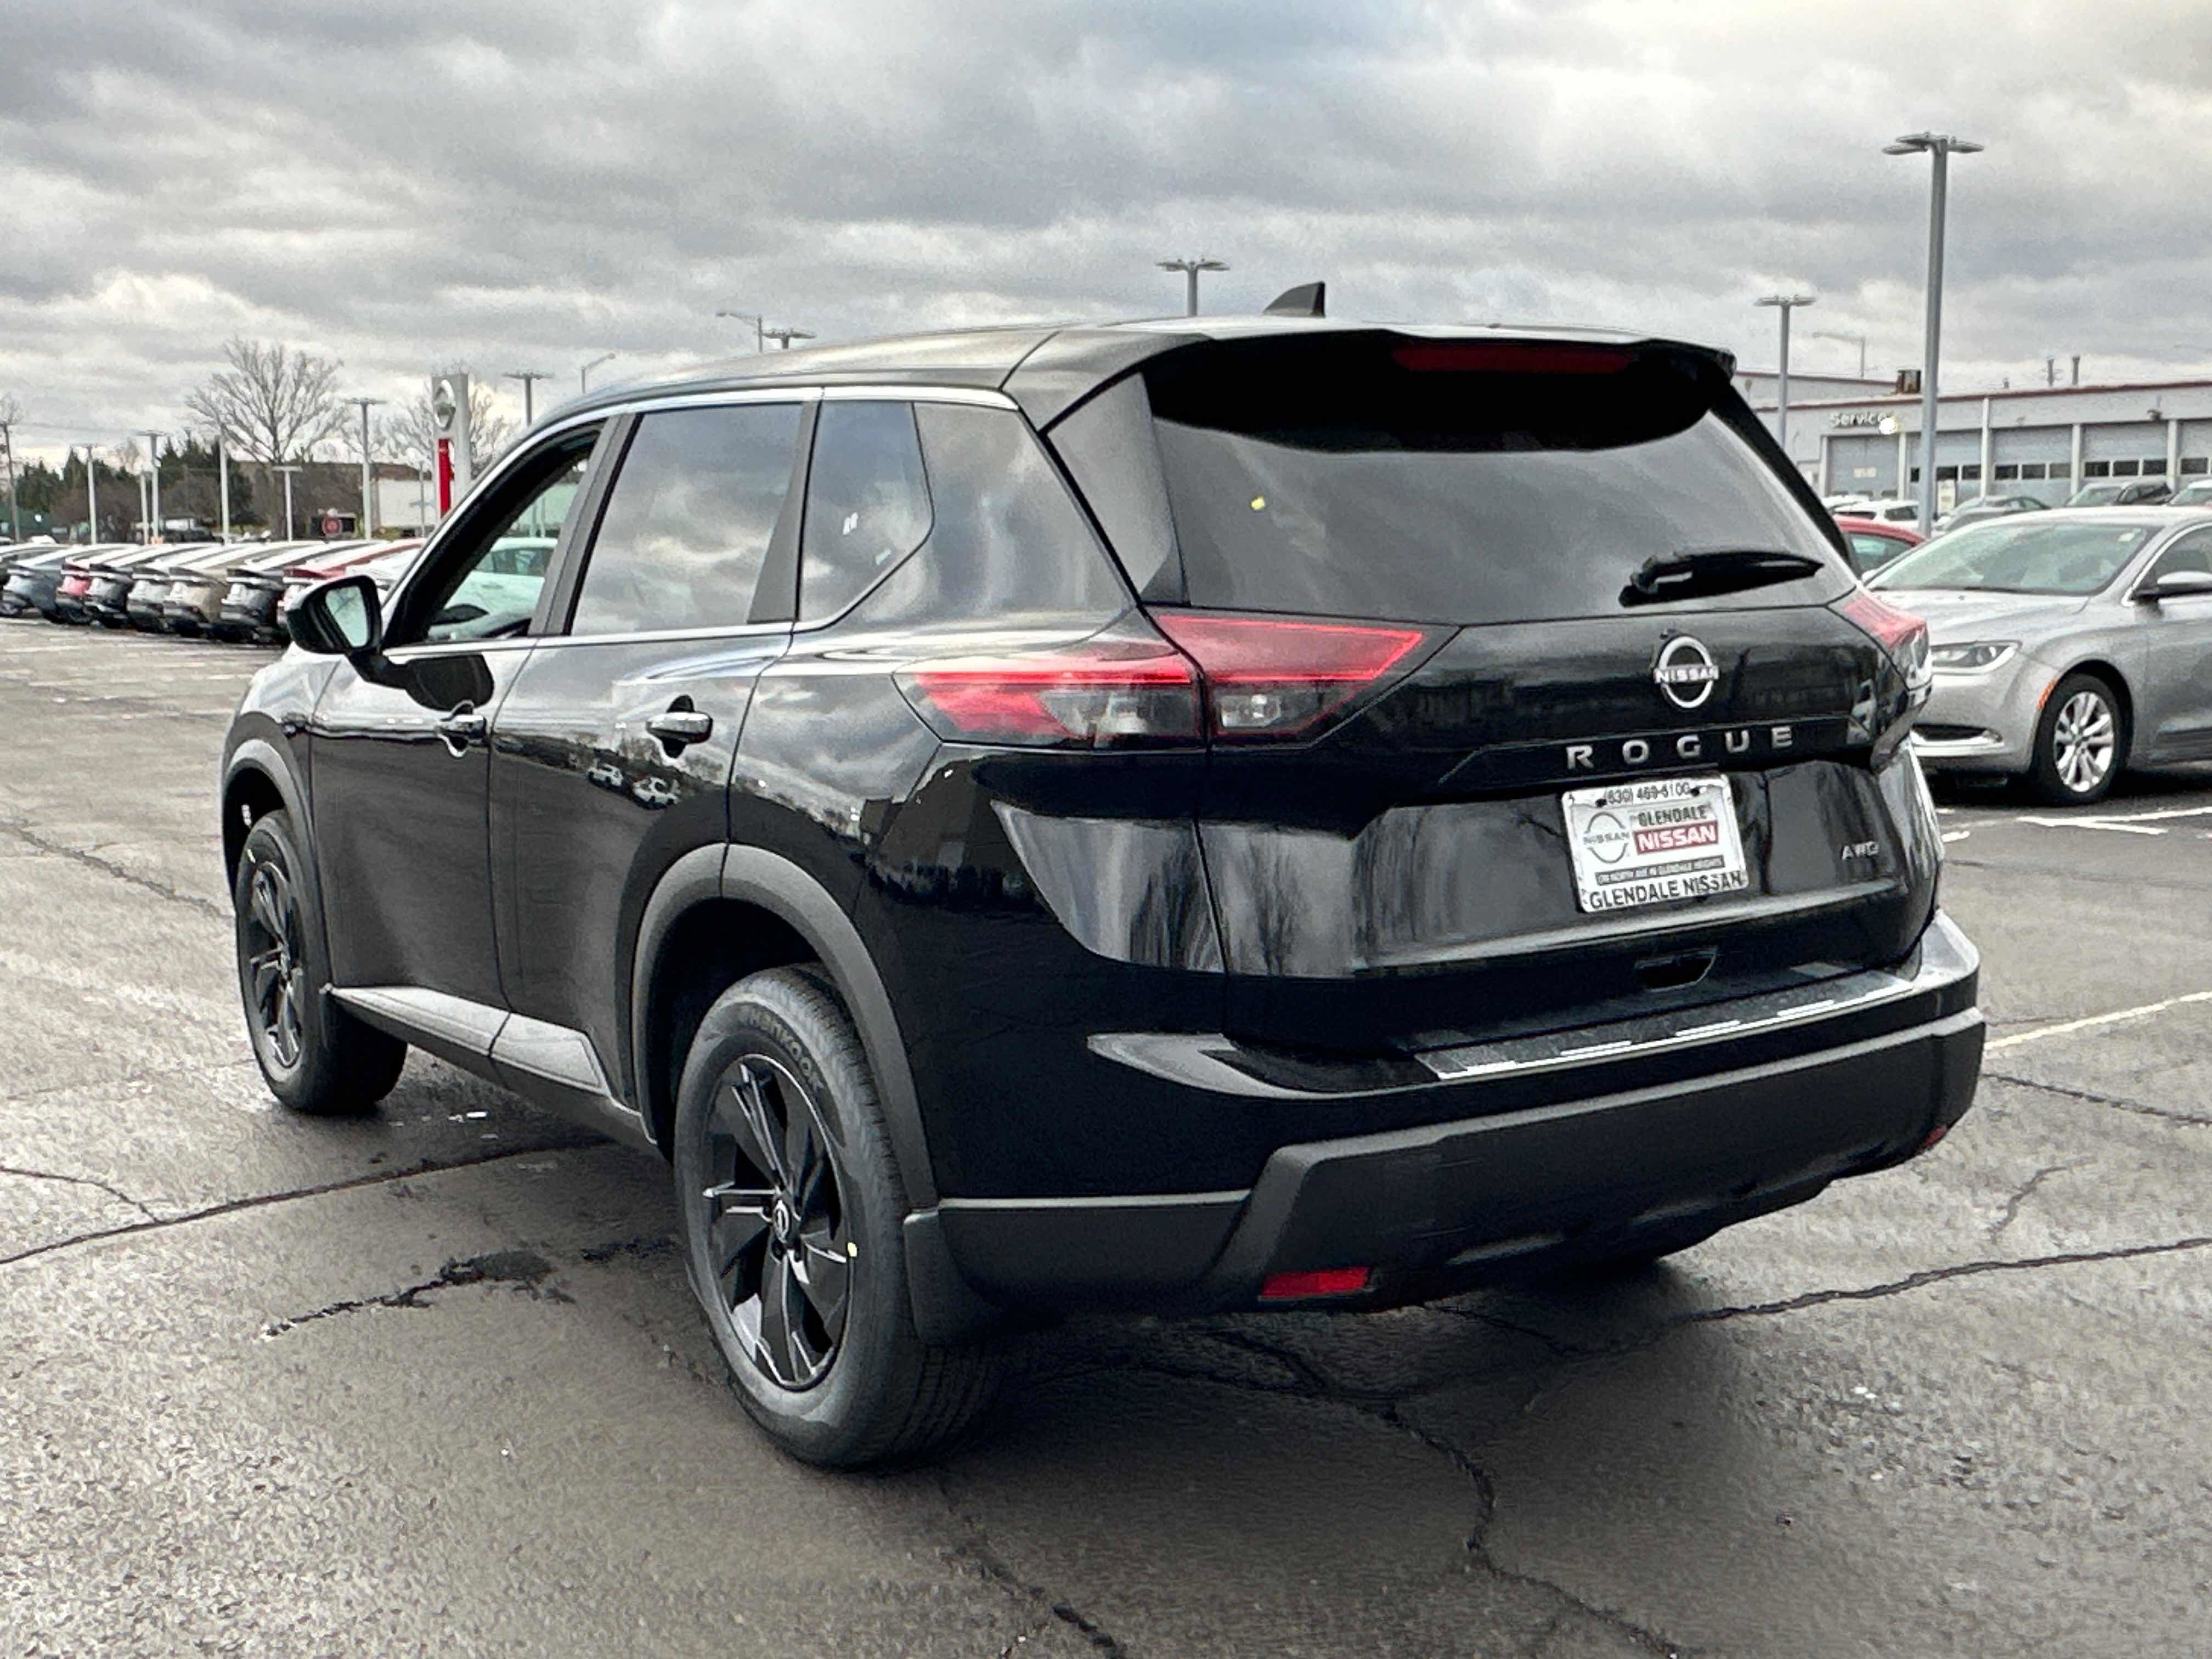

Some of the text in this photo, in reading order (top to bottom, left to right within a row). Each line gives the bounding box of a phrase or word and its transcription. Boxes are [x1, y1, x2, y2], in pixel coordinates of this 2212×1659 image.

[1654, 665, 1719, 684] NISSAN
[1566, 725, 1793, 769] ROGUE
[1638, 805, 1707, 827] GLENDALE
[1637, 824, 1717, 851] NISSAN
[1590, 880, 1680, 909] GLENDALE
[1683, 870, 1742, 895] NISSAN
